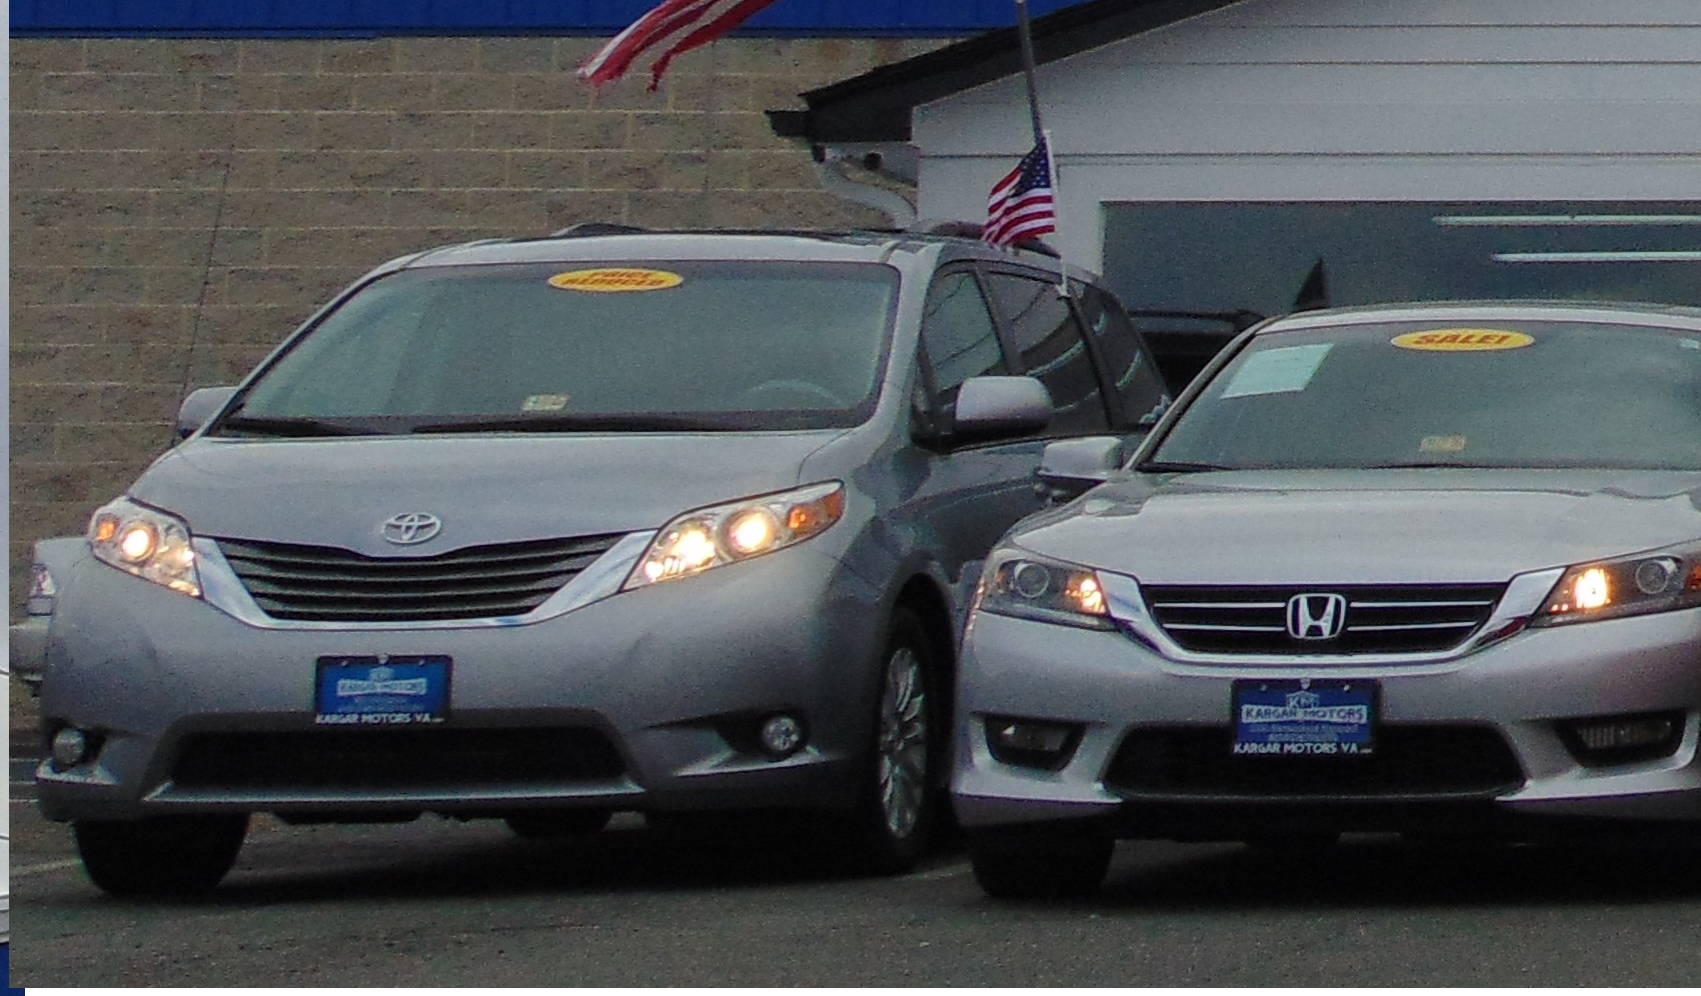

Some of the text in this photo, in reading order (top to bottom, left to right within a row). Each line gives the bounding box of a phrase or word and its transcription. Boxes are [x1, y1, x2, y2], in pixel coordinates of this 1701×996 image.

[361, 713, 412, 723] MOTORS
[1245, 707, 1364, 721] KARGAR MOTORS
[1233, 743, 1281, 754] KARGAR
[1283, 742, 1338, 754] MOTORS
